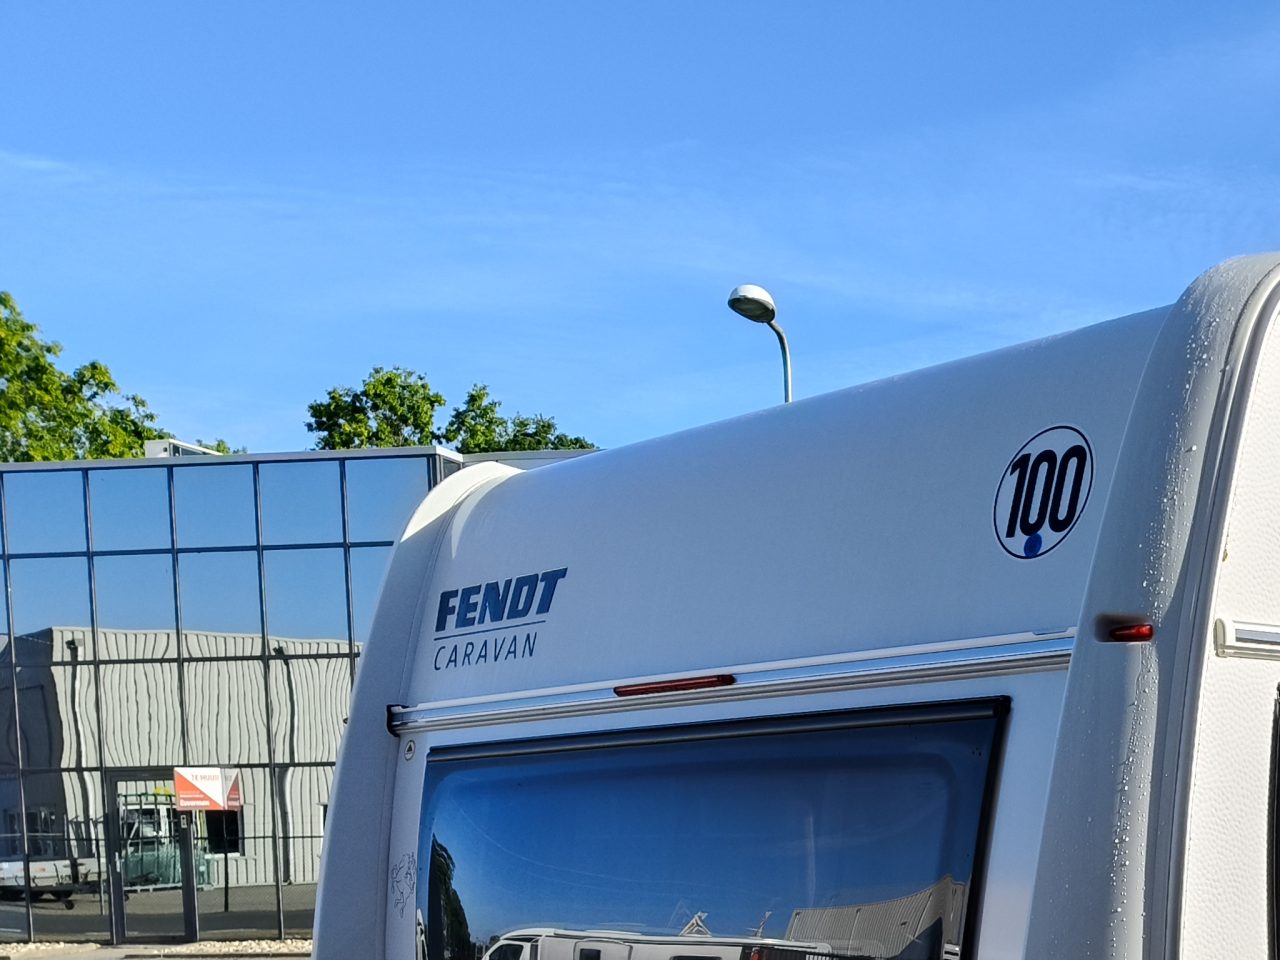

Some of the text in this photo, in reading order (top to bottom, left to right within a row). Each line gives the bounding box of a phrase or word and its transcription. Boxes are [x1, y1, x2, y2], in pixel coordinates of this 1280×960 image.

[1005, 444, 1088, 539] 100
[434, 566, 568, 633] FENDT
[433, 631, 538, 671] CARAVAN
